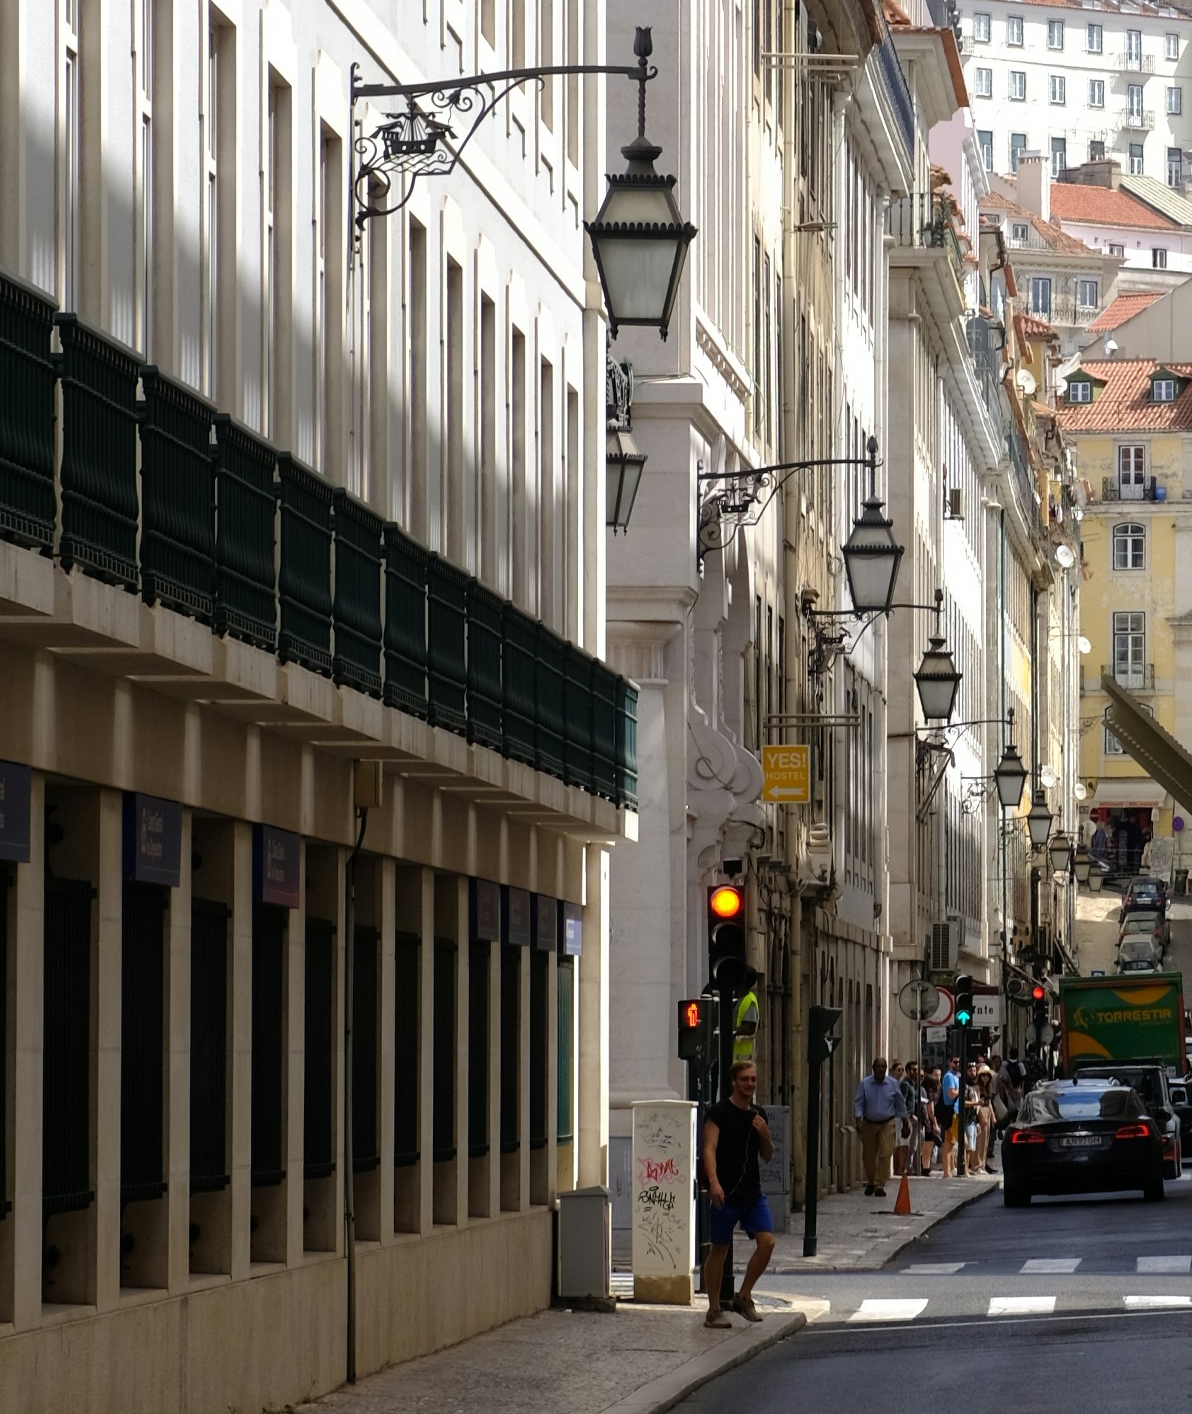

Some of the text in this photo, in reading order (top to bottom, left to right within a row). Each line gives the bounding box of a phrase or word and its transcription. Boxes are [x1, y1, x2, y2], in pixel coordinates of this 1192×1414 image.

[767, 752, 806, 768] YES!
[766, 771, 806, 780] HOSTEL
[1097, 1009, 1171, 1023] TORRESTIR
